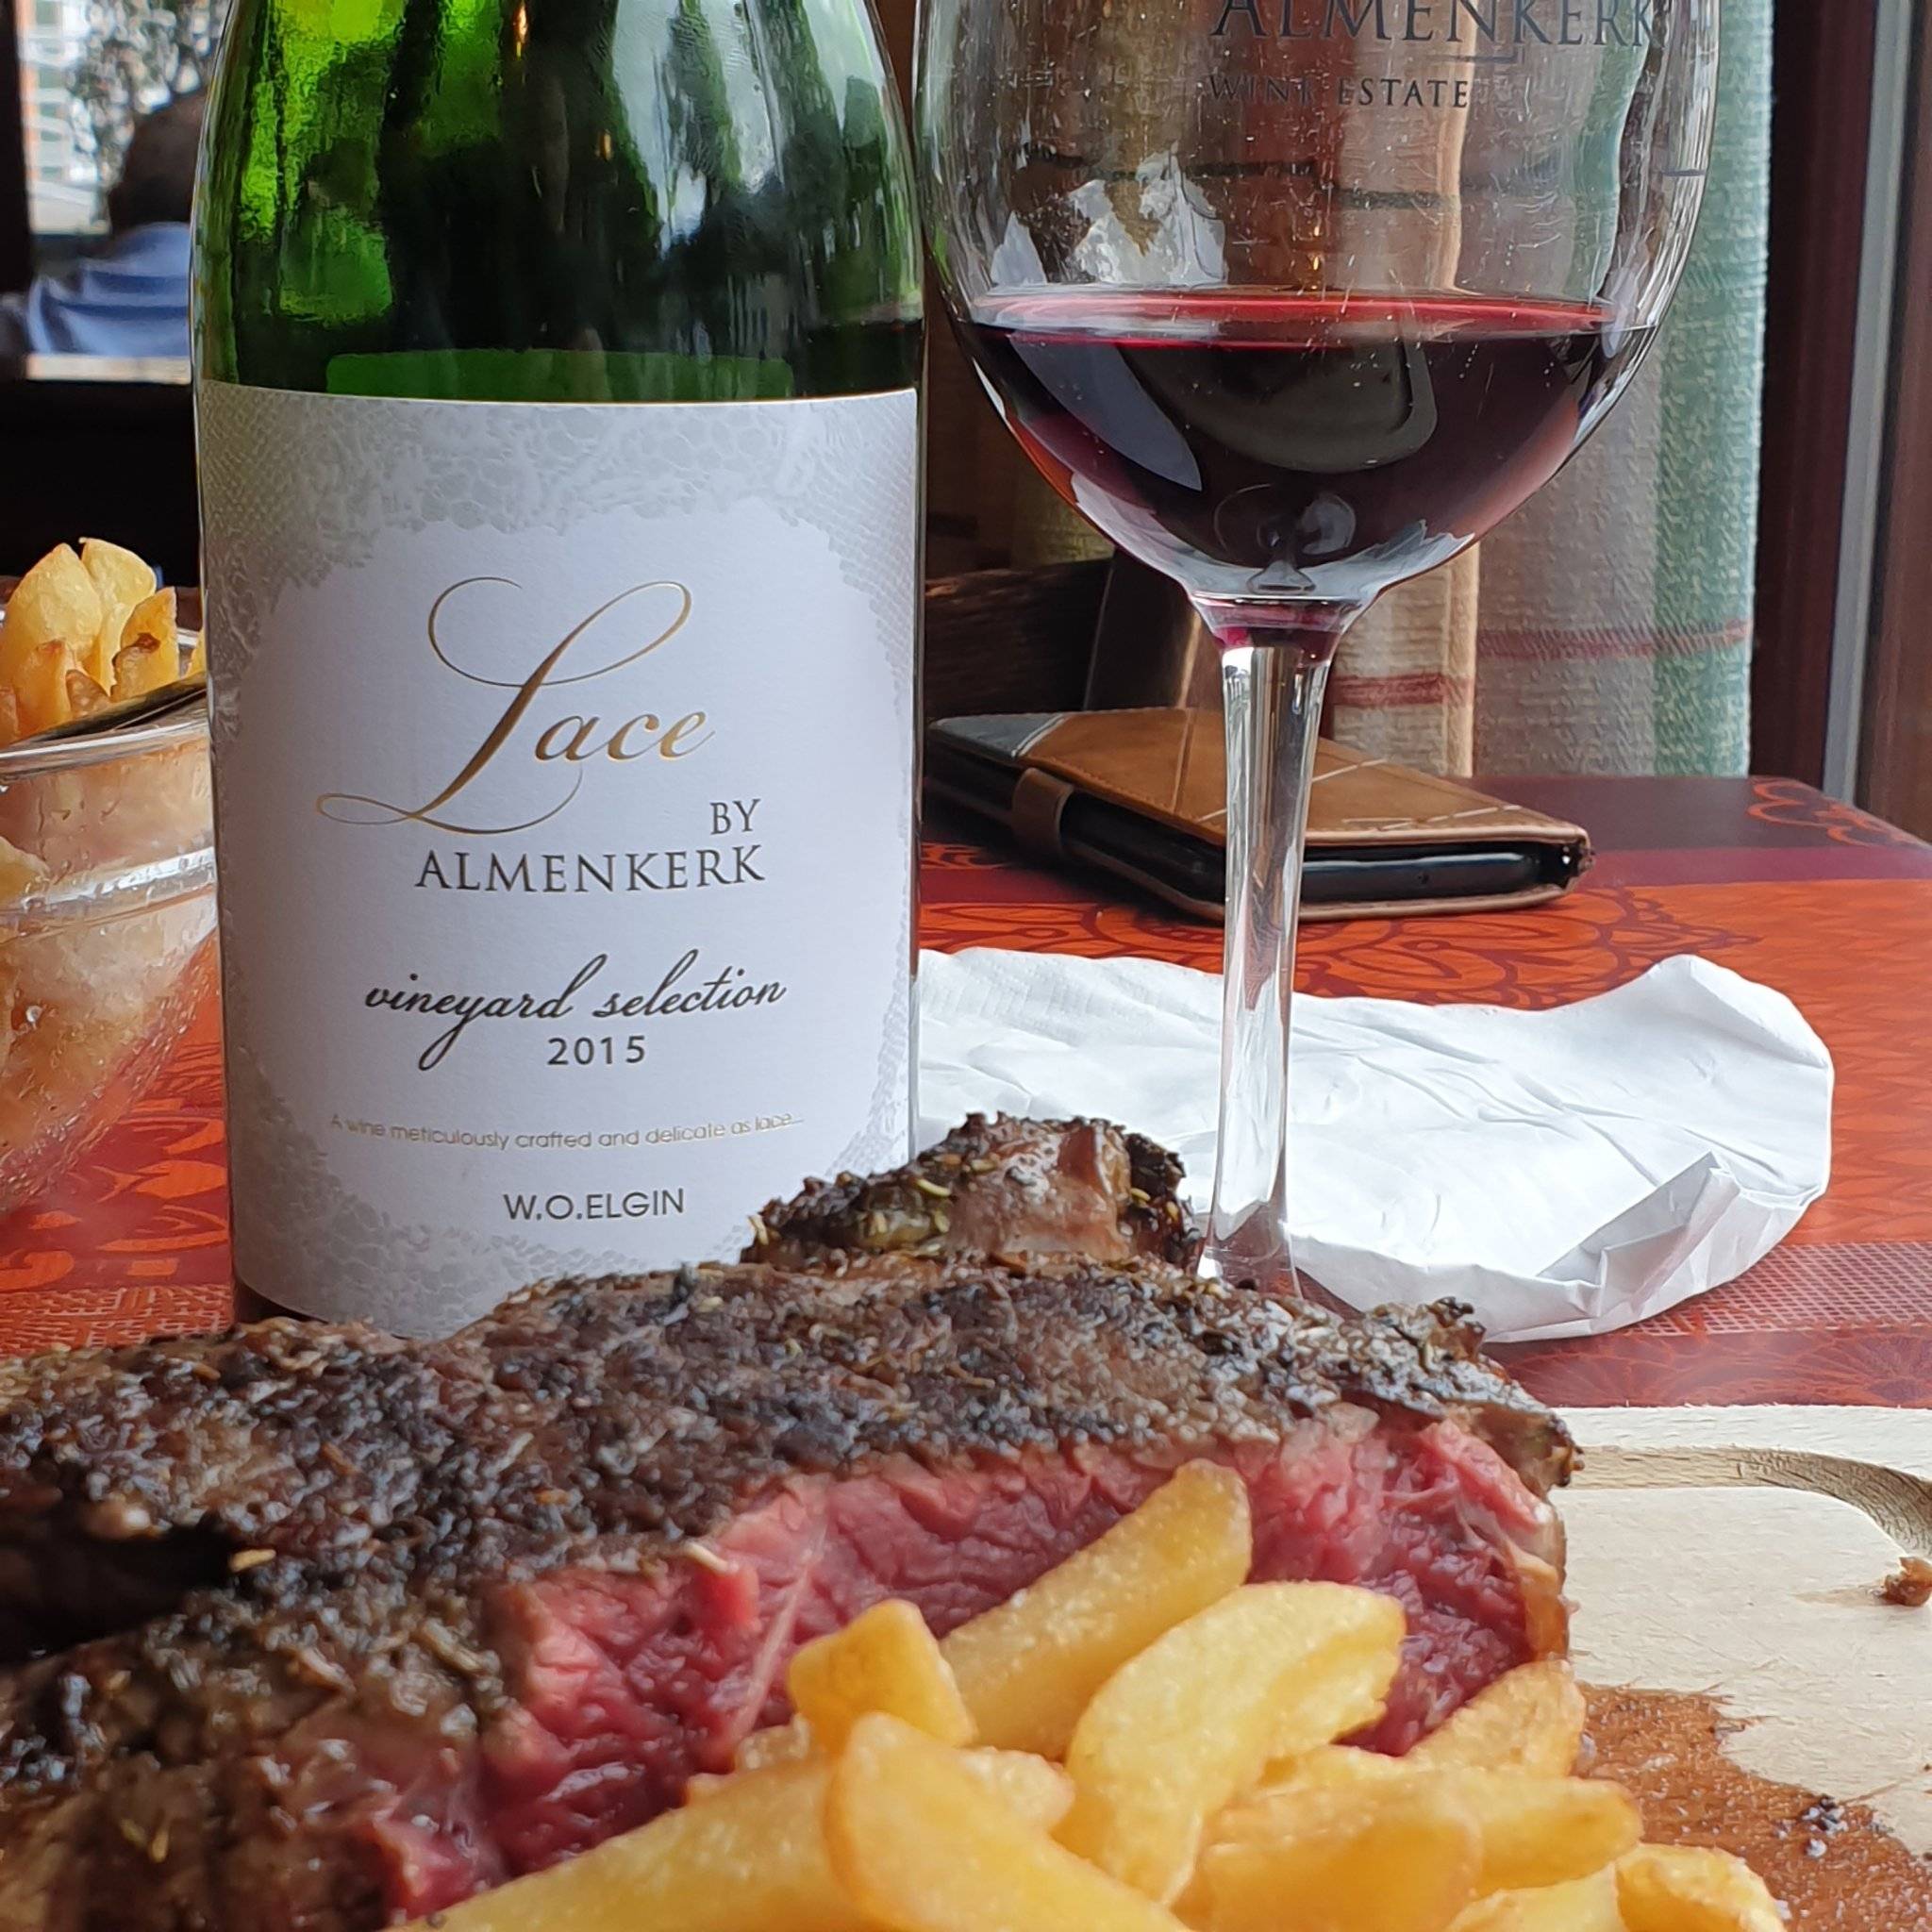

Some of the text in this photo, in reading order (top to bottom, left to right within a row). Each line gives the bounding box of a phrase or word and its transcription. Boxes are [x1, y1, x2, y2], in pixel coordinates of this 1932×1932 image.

[1209, 0, 1664, 46] ALMENKERK
[1338, 76, 1469, 108] ESTATE
[316, 576, 716, 835] Lace
[709, 798, 761, 835] BY
[415, 844, 766, 893] ALMENKERK
[364, 949, 787, 1072] vineyard selection
[547, 1034, 646, 1067] 2015
[331, 1113, 343, 1129] A
[345, 1118, 386, 1138] wine
[390, 1124, 509, 1151] meticulously
[515, 1130, 592, 1149] crafted
[598, 1129, 640, 1147] and
[645, 1122, 726, 1145] delicate
[731, 1121, 752, 1135] as
[503, 1187, 685, 1221] W.O.ELGIN
